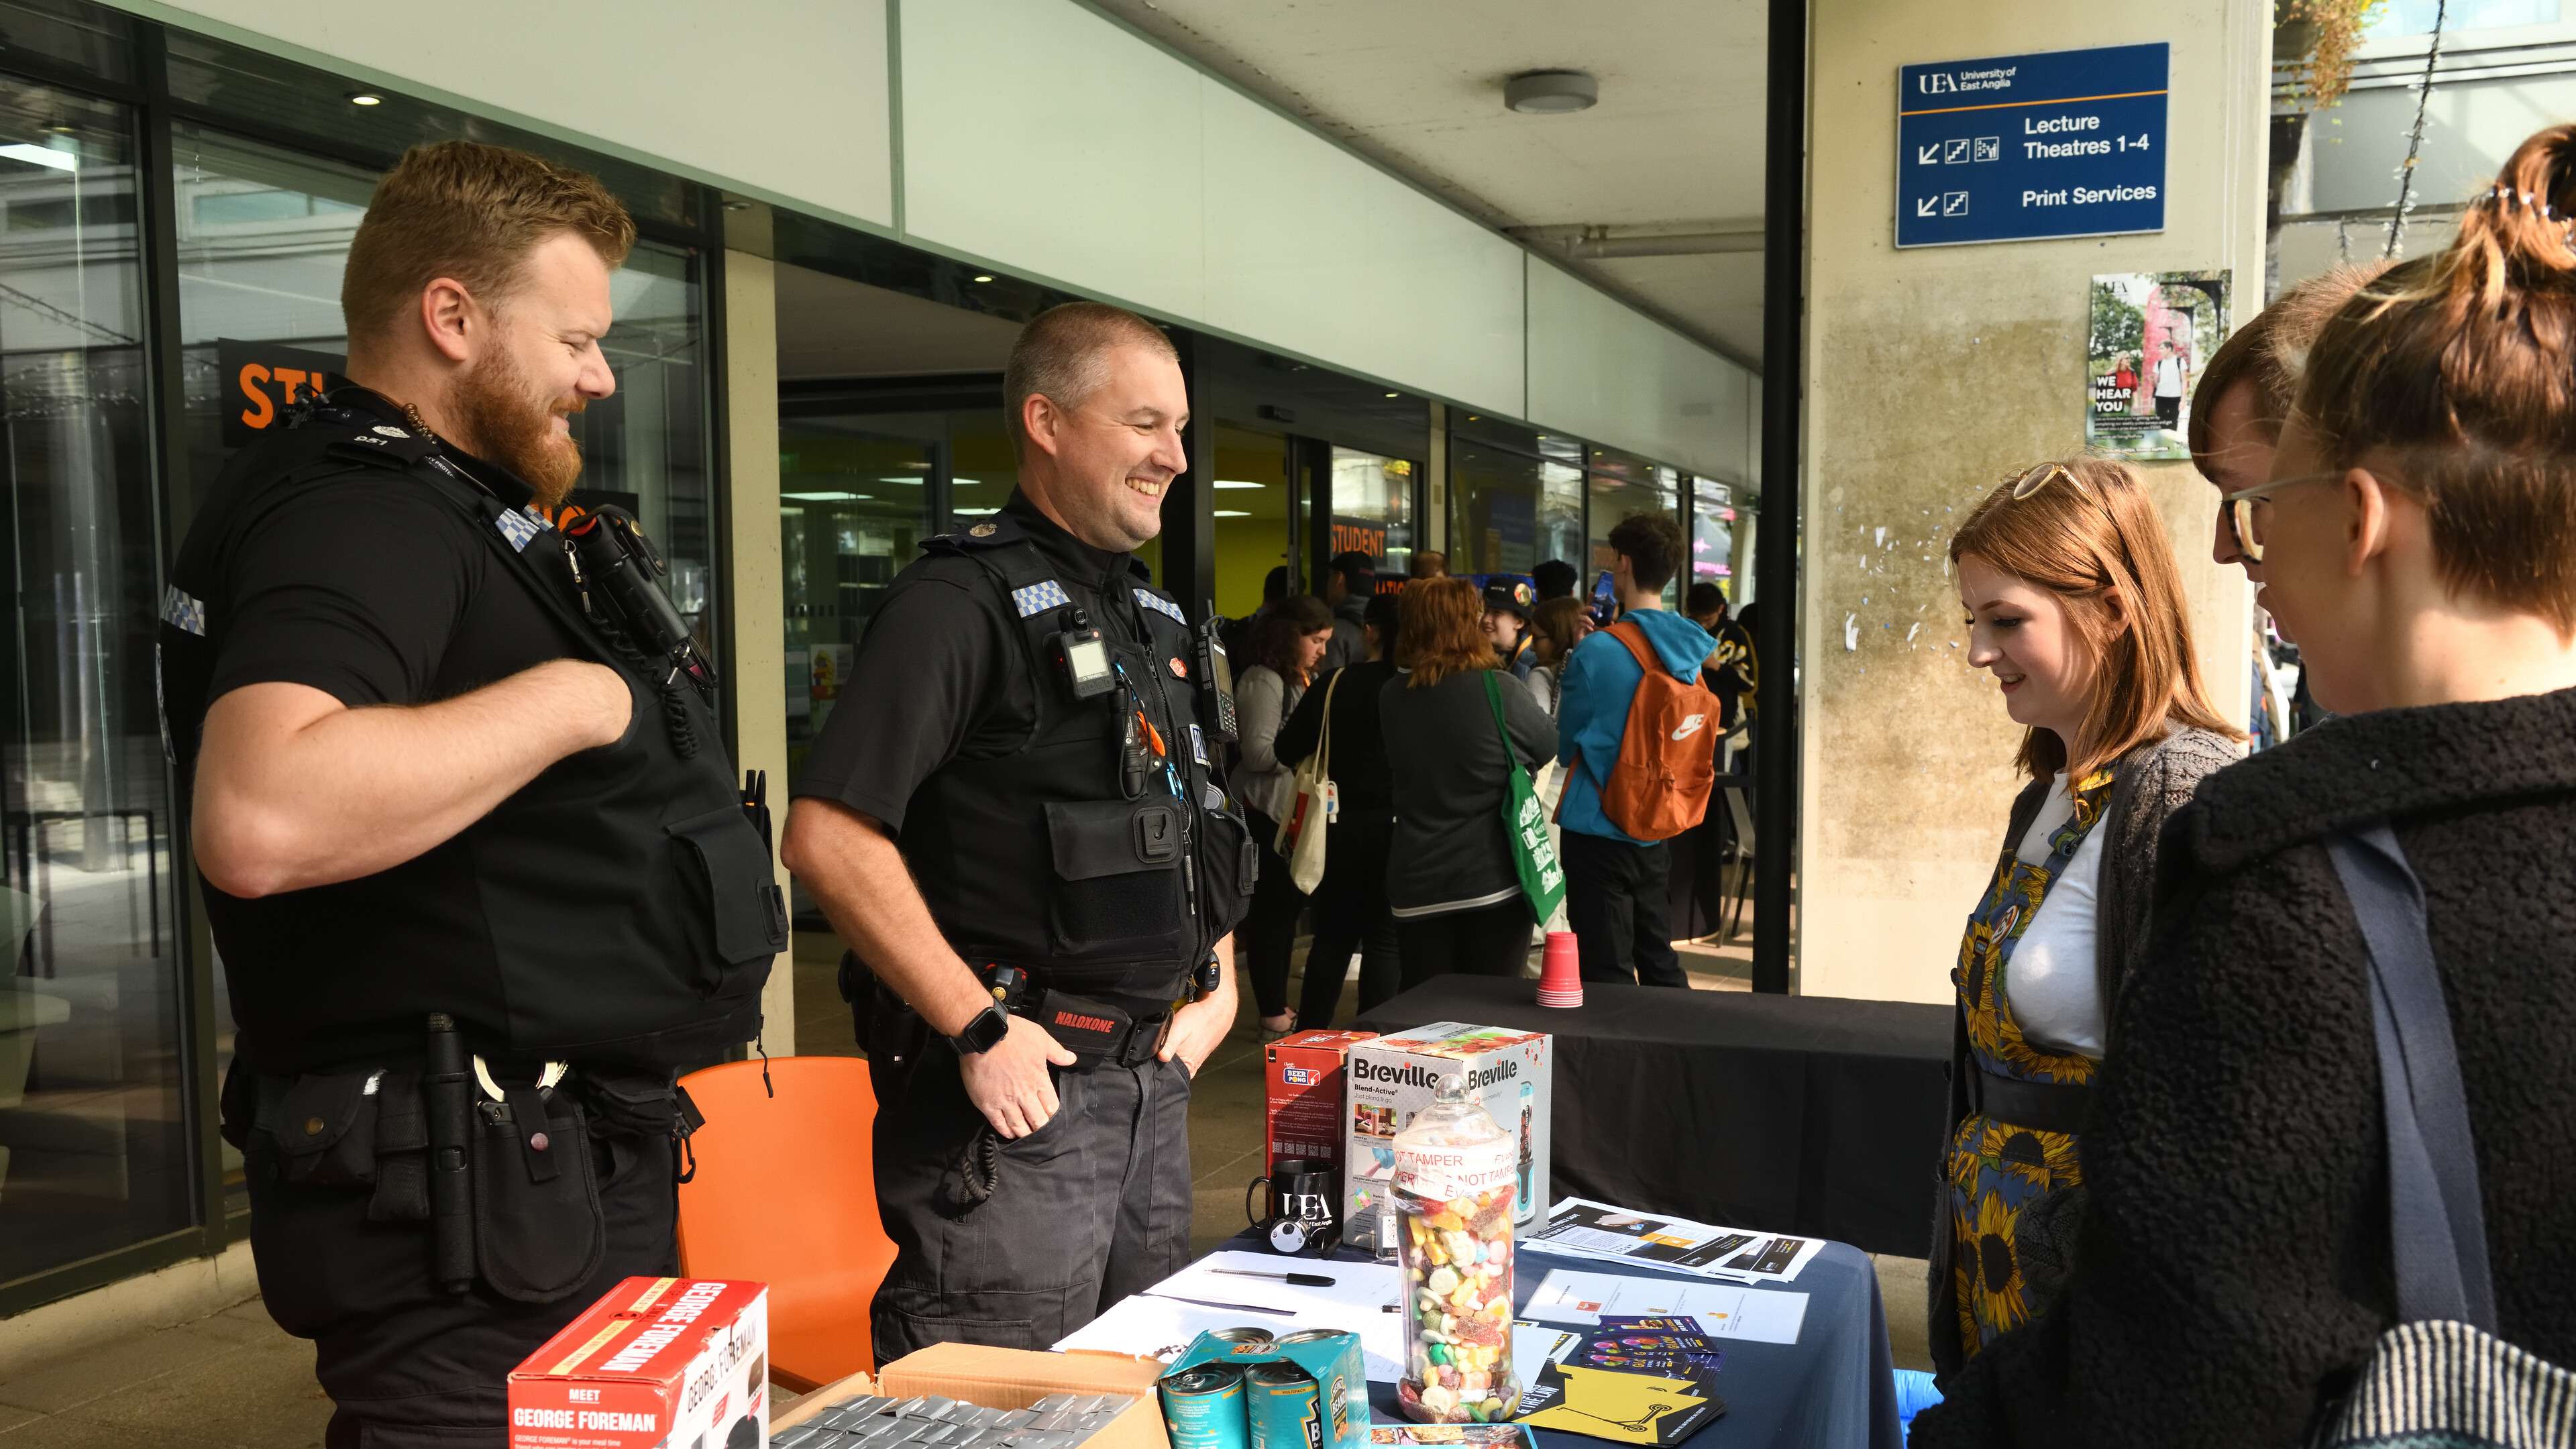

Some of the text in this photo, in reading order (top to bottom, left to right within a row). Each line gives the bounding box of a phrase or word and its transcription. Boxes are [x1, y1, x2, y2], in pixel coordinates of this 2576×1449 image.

[1961, 66, 2017, 81] University of
[1919, 73, 1960, 94] UEA
[1960, 77, 2010, 91] East Anglia
[2025, 114, 2100, 135] Lecture
[2023, 133, 2149, 159] Theatres 1-4
[2023, 184, 2156, 207] Print Services
[2096, 375, 2116, 387] WE
[2096, 388, 2131, 400] HEAR
[2096, 400, 2123, 413] YOU
[354, 435, 388, 446] 951
[1680, 713, 1705, 731] NIKE
[1055, 1010, 1114, 1034] NALOXONE
[1354, 1058, 1439, 1089] Breville
[1468, 1059, 1517, 1090] Breville
[1407, 1152, 1464, 1167] TAMPER
[1283, 1193, 1333, 1220] UEA
[598, 1282, 727, 1373] GEORGE FOREMAN
[688, 1319, 756, 1413] GEORG FOREMAN
[569, 1389, 600, 1401] MEET
[1531, 1385, 1560, 1399] LAW
[1519, 1397, 1545, 1409] THE
[514, 1407, 655, 1432] GEORGE FOREMAN
[607, 1439, 621, 1447] time
